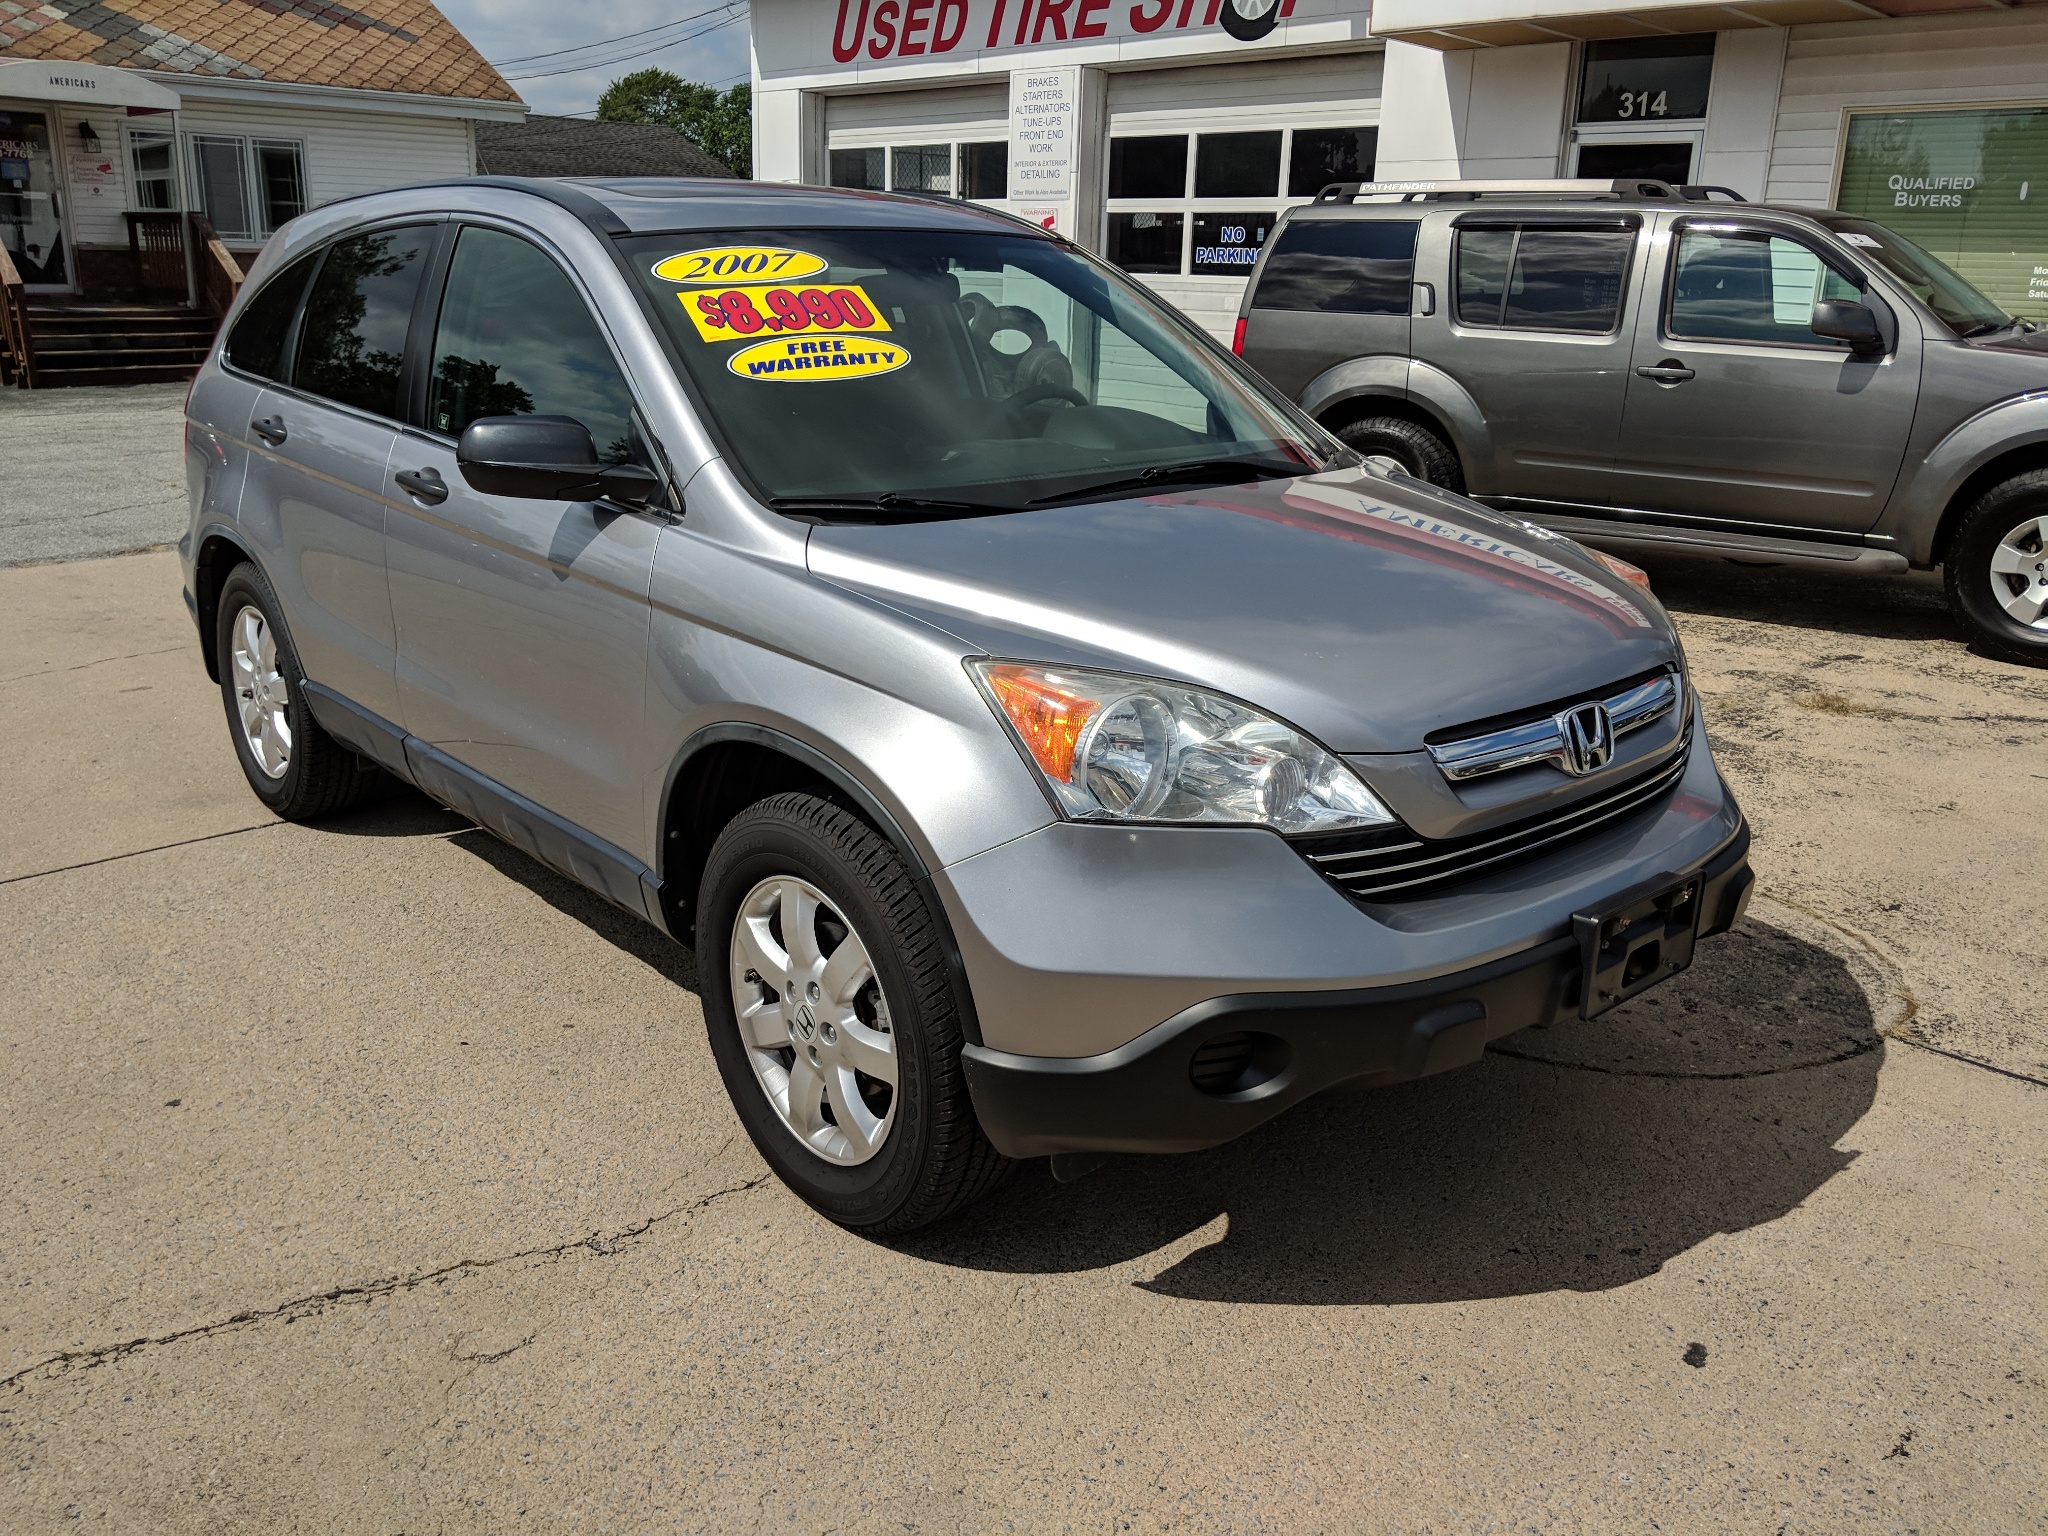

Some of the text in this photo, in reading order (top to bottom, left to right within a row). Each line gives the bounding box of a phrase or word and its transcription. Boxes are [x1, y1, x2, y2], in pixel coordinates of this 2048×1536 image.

[832, 0, 969, 63] USED
[50, 76, 96, 89] AMERICARS
[1027, 76, 1059, 88] BRAKES
[1022, 89, 1064, 101] STARTERS
[1014, 102, 1071, 115] ALTERNATORS
[1618, 90, 1668, 118] 314
[1022, 116, 1062, 128] TUNE-UPS
[1019, 129, 1064, 141] FRONT END
[1029, 143, 1053, 153] WORK
[1014, 160, 1037, 168] INTERIOR
[1042, 159, 1068, 167] EXTERIOR
[1020, 169, 1061, 180] DETAILING
[1362, 182, 1436, 192] PATHFINDER
[1888, 174, 1975, 191] QUALIFIED
[1894, 191, 1962, 208] BUYERS
[1220, 226, 1246, 243] NO
[681, 252, 798, 280] 2007
[697, 289, 876, 334] $8,990
[786, 340, 847, 356] FREE
[747, 351, 896, 376] WARRANTY
